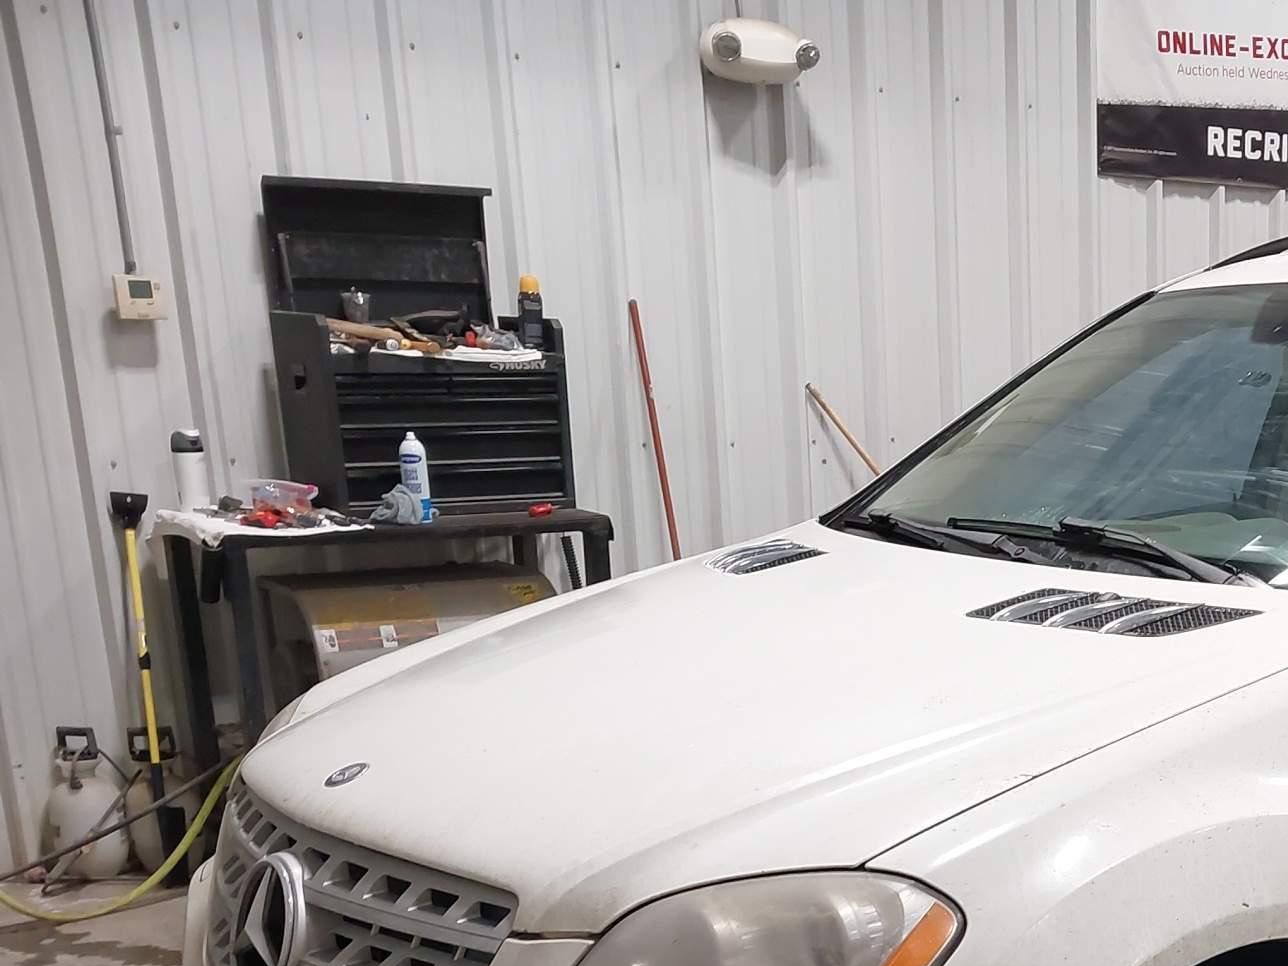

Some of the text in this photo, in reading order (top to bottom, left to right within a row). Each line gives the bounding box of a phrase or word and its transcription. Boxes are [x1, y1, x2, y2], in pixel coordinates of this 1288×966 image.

[1177, 64, 1219, 77] Auction
[1222, 66, 1244, 78] held
[505, 360, 547, 370] HUSKY
